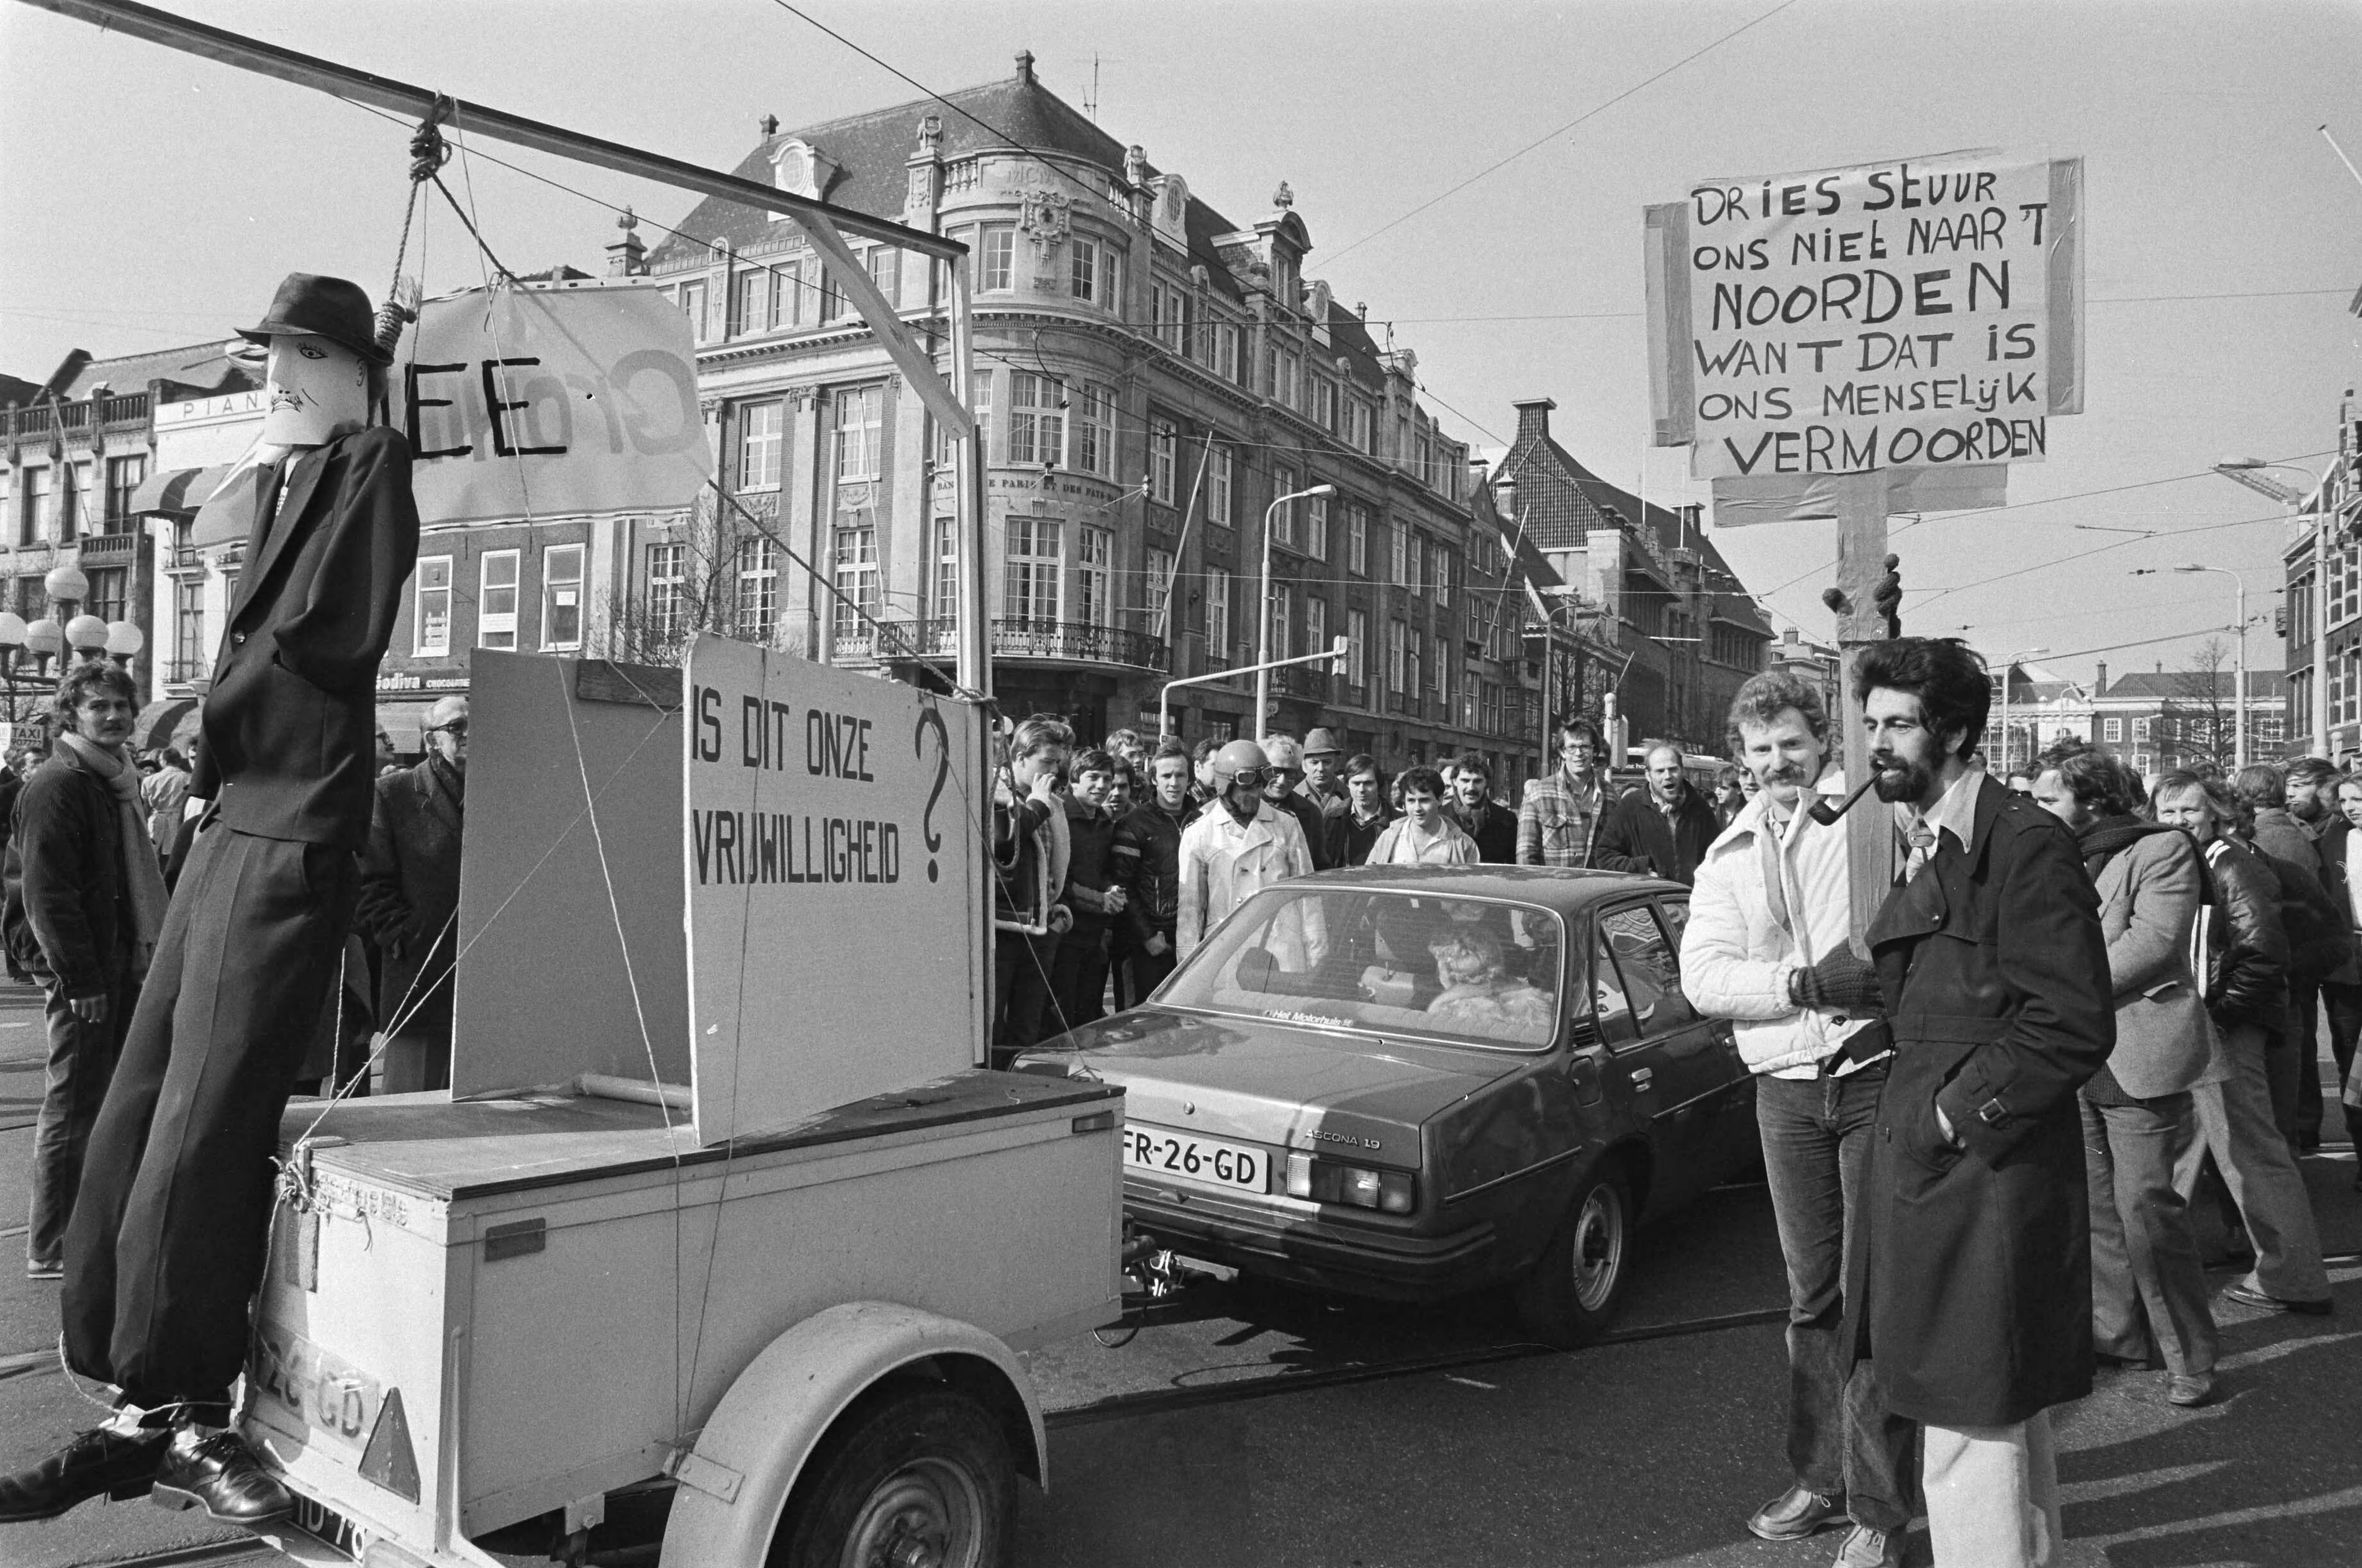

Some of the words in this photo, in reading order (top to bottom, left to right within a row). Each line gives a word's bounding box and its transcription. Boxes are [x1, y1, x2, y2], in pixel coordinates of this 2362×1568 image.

[1694, 239, 1769, 270] ONS
[1907, 207, 2006, 255] NAAR
[1713, 260, 2010, 330] NOORDEN
[1695, 339, 1842, 377] WANT
[1856, 332, 1953, 371] DAT
[183, 393, 258, 418] PIAN
[381, 357, 567, 459] EE
[1699, 387, 1792, 421] ONS
[1724, 416, 2046, 475] VERMOORDEN
[937, 481, 955, 491] BAN
[1062, 484, 1082, 494] DES
[12, 727, 40, 739] TAXI
[692, 685, 722, 763] IS
[743, 695, 789, 771] DIT
[806, 709, 874, 782] ONZE
[693, 809, 899, 885] VRIJWILLIGHEID
[915, 707, 949, 883] ?
[1272, 1010, 1291, 1020] Het
[1291, 1012, 1342, 1027] Motorhuis
[1306, 1129, 1359, 1146] ASCONA
